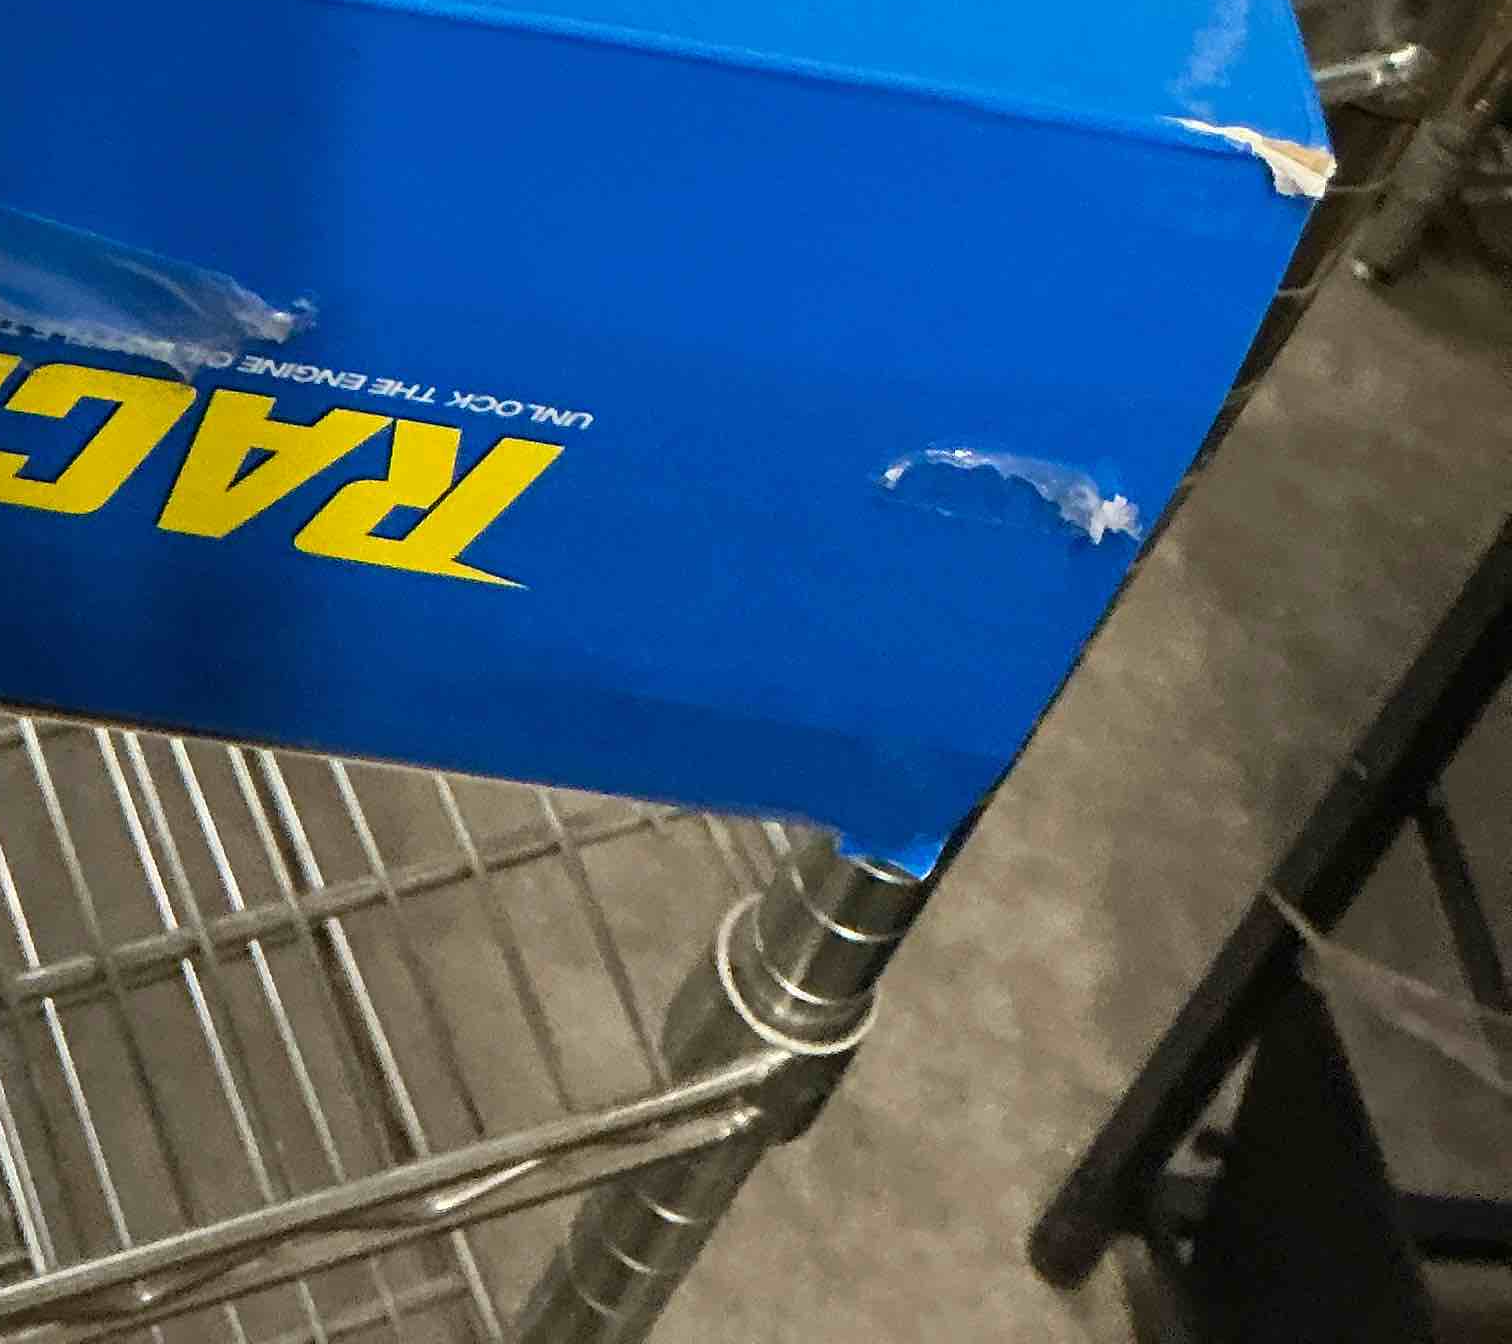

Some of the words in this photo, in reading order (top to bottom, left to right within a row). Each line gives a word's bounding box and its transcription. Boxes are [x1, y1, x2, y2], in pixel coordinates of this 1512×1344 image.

[236, 354, 368, 391] ENGINE
[367, 377, 438, 405] THE
[443, 390, 594, 431] UNLOCK
